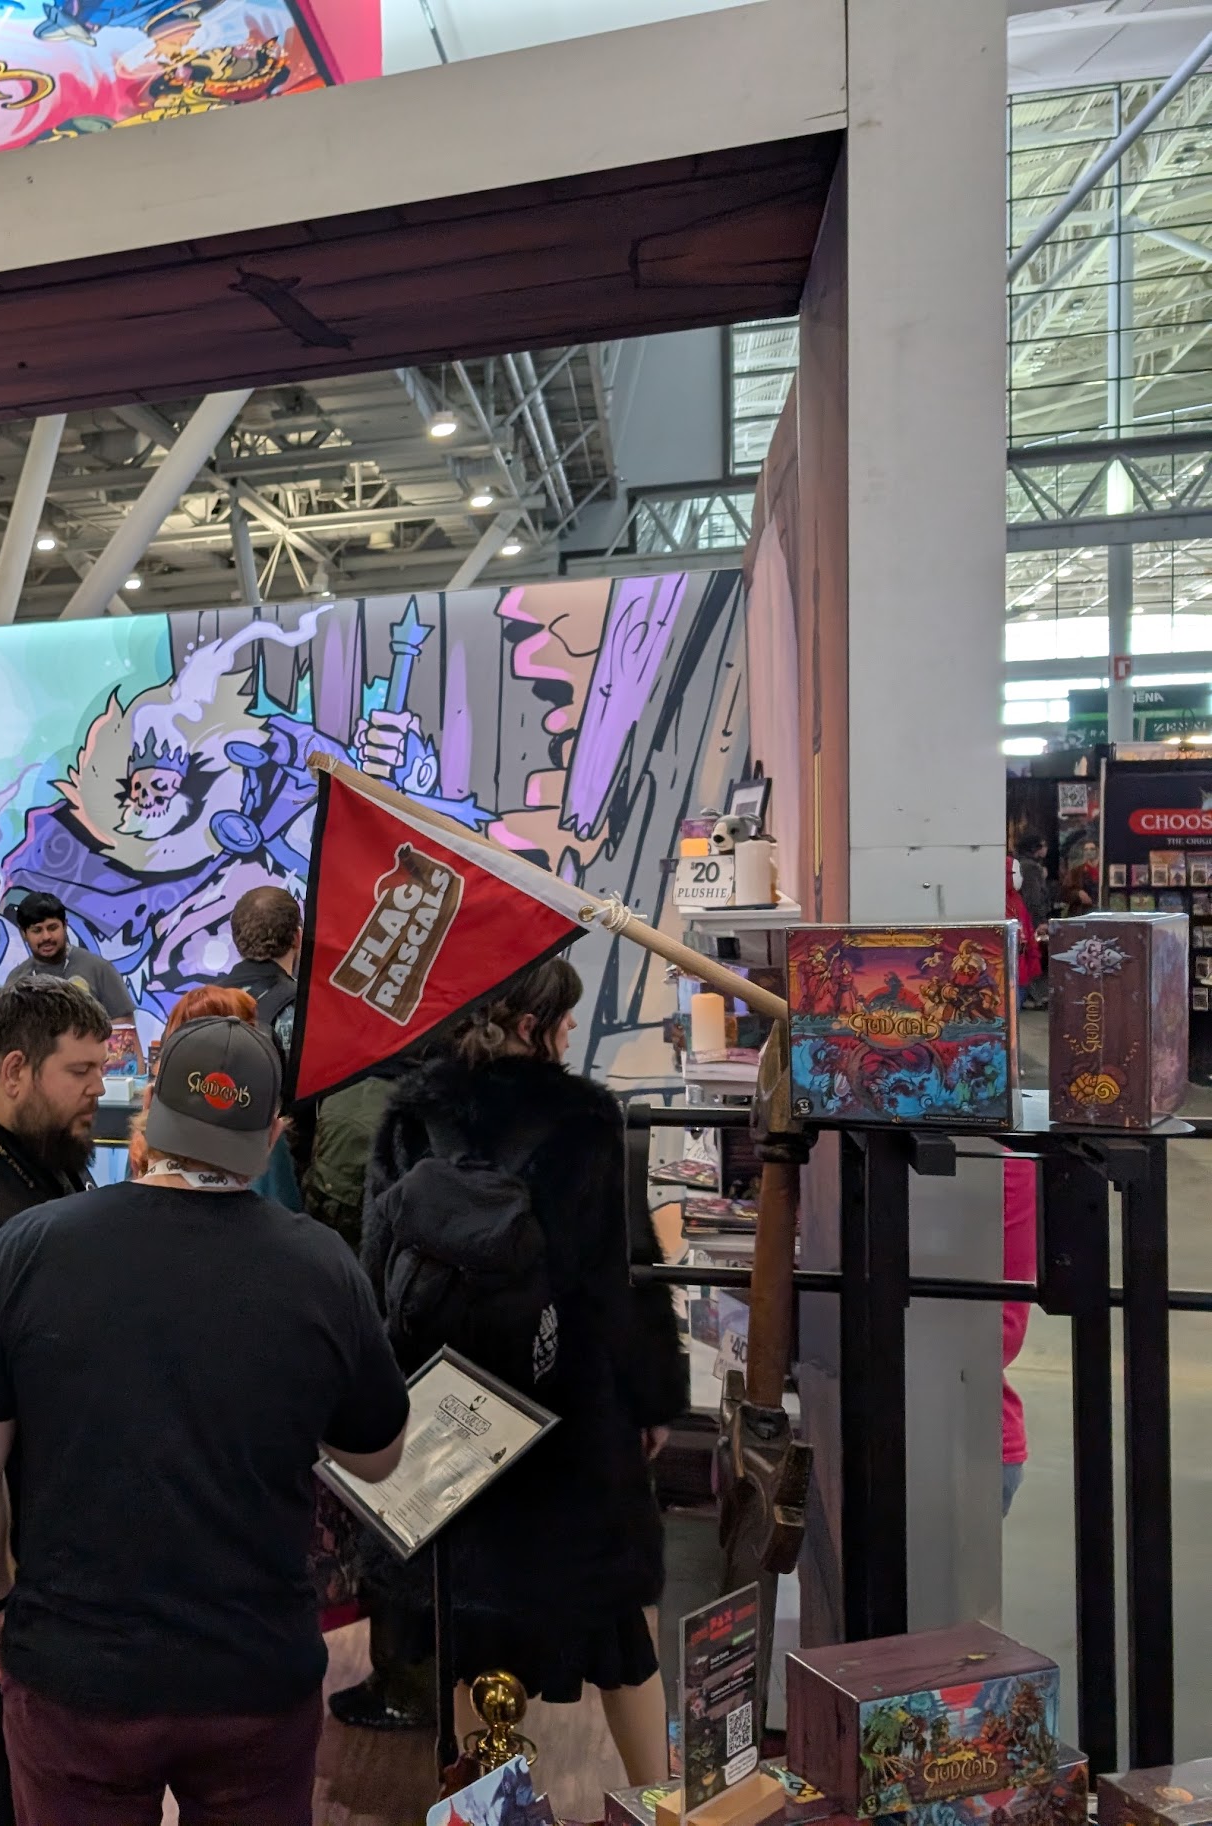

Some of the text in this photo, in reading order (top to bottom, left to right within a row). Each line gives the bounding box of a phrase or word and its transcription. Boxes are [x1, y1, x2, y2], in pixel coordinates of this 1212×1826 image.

[677, 888, 728, 898] PLUSHIE
[690, 862, 720, 883] $20
[350, 883, 424, 978] FLAG
[375, 869, 450, 1008] RASCALS
